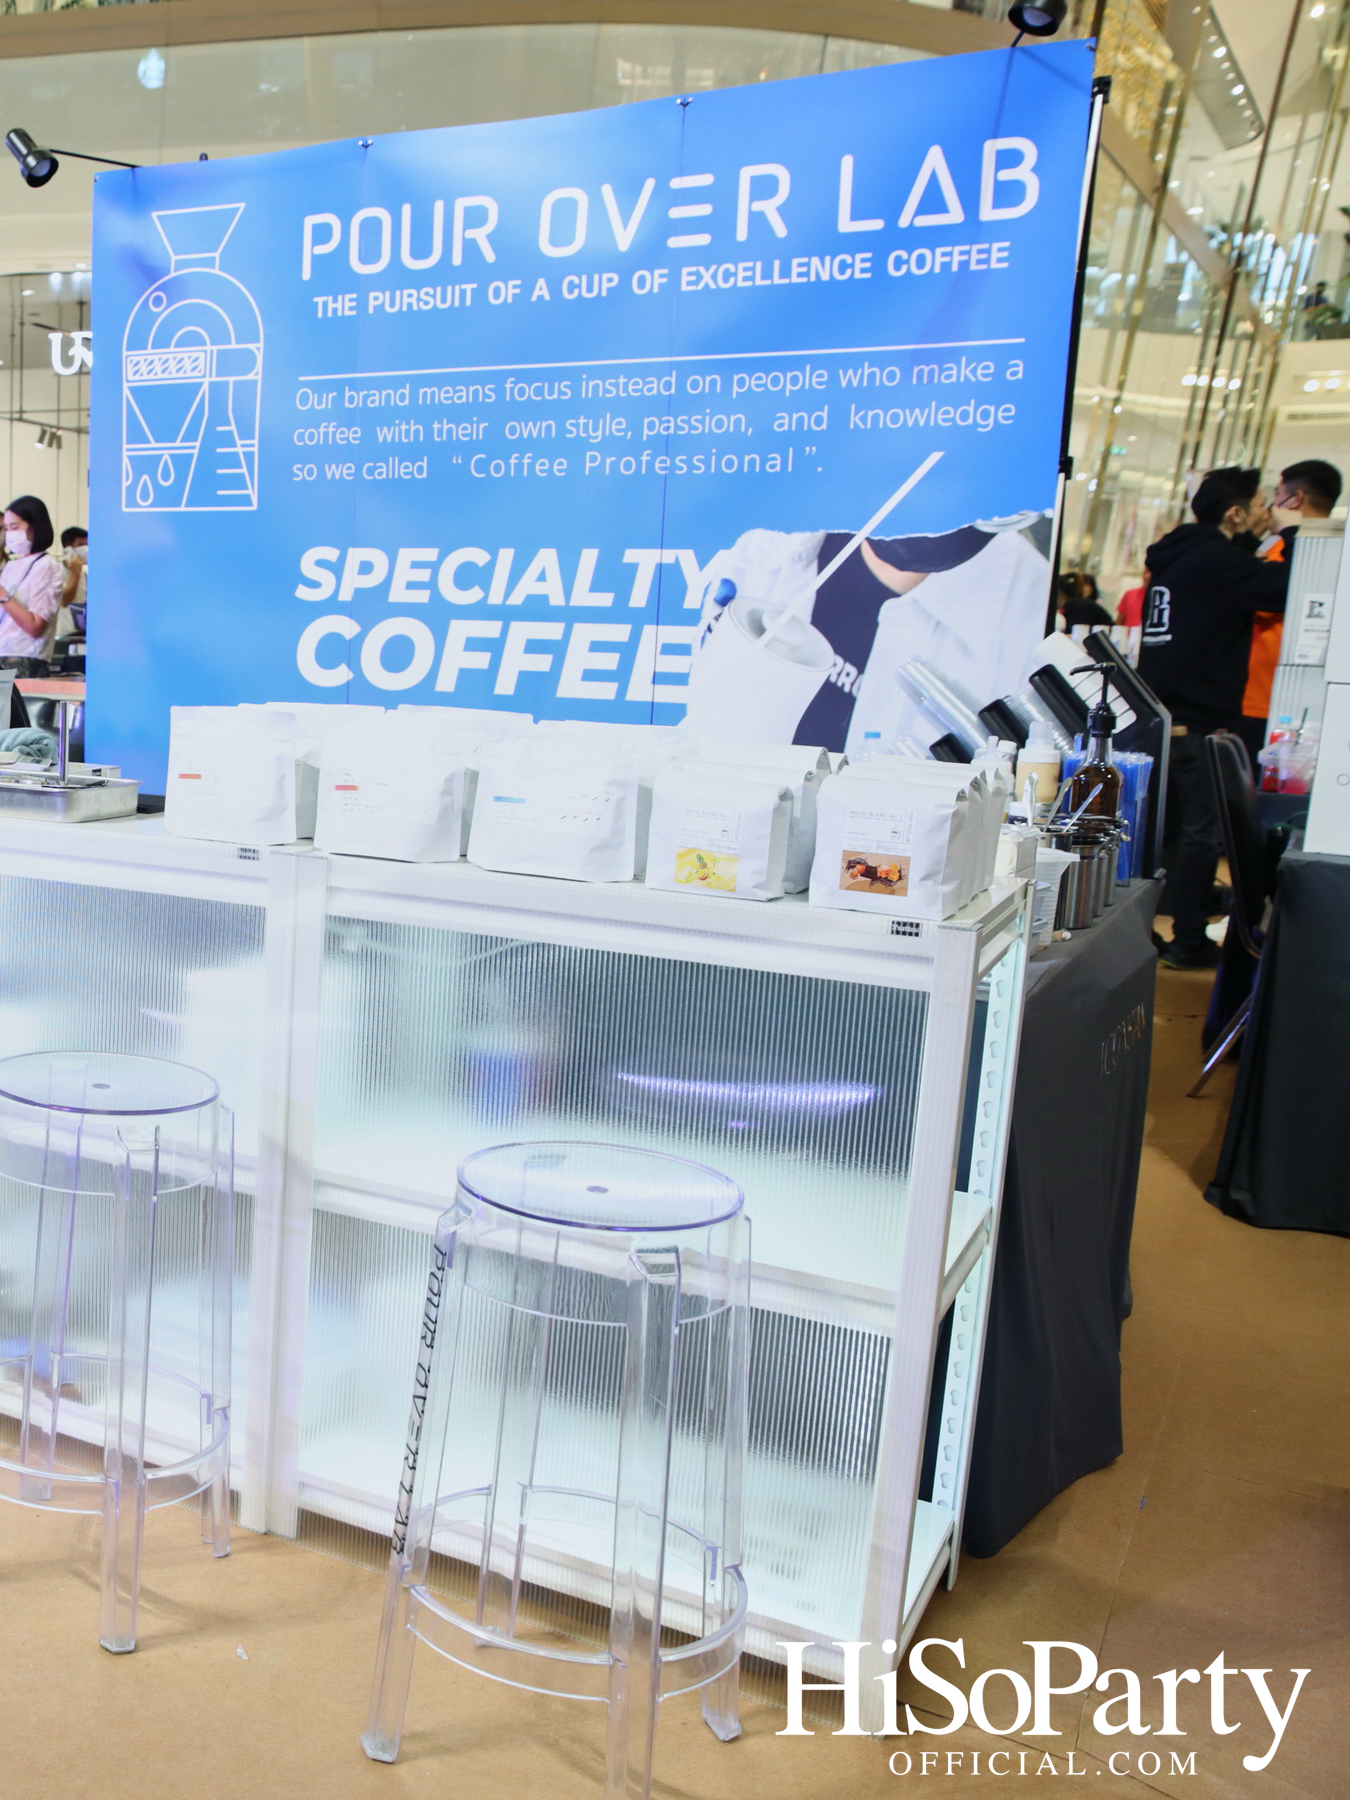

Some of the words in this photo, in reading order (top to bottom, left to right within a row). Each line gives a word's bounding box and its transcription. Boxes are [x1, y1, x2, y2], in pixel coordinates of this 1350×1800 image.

[302, 195, 500, 280] POUR
[539, 163, 790, 257] OVER
[838, 137, 1040, 232] LAB
[314, 294, 357, 318] THE
[369, 283, 478, 313] PURSUIT
[488, 280, 522, 304] OF
[531, 278, 550, 301] A
[562, 273, 619, 299] CUP
[632, 269, 668, 294] OF
[681, 253, 872, 291] EXCELLENCE
[888, 241, 1010, 276] COFFEE
[296, 388, 337, 410] Our
[345, 383, 410, 408] brand
[419, 385, 495, 404] means
[505, 378, 572, 401] focus
[582, 371, 676, 398] instead
[687, 375, 721, 394] on
[733, 364, 828, 398] people
[839, 362, 900, 387] who
[913, 356, 994, 384] make
[1006, 360, 1024, 380] a
[294, 422, 361, 445] coffee
[377, 420, 423, 442] with
[432, 417, 489, 441] their
[506, 420, 556, 439] own
[566, 412, 632, 442] style,
[643, 409, 752, 440] passion,
[774, 405, 828, 431] and
[850, 399, 1016, 431] knowledge
[293, 464, 317, 480] so
[325, 463, 355, 479] we
[363, 456, 427, 479] called
[294, 546, 730, 609] SPECIALTY
[296, 615, 692, 704] COFFEE
